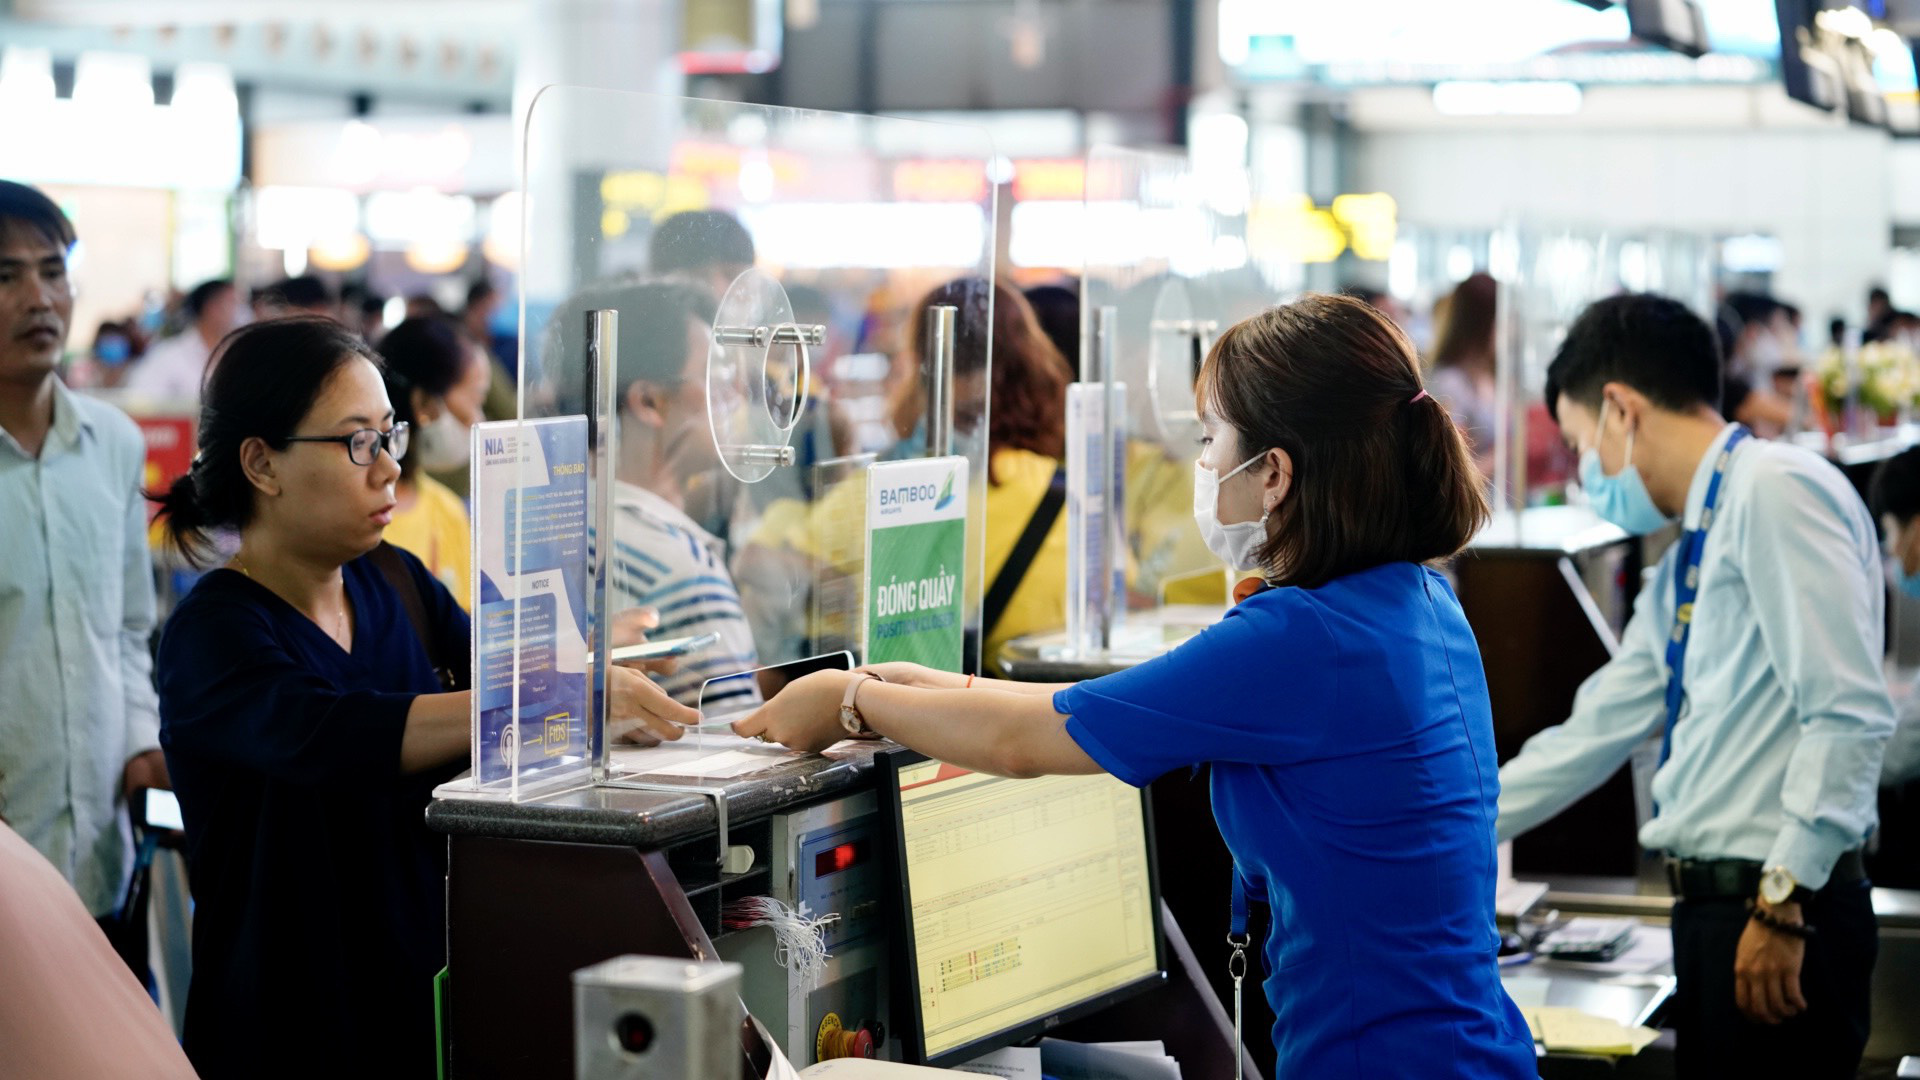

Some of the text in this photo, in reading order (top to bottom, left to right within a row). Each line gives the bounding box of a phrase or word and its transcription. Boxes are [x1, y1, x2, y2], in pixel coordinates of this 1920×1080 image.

[485, 438, 504, 455] NIA
[553, 463, 573, 476] THÔNG
[880, 484, 936, 505] BAMBOO
[532, 578, 549, 589] NOTICE
[877, 565, 955, 617] ĐÓNG QUẦY
[877, 619, 918, 638] POSITION
